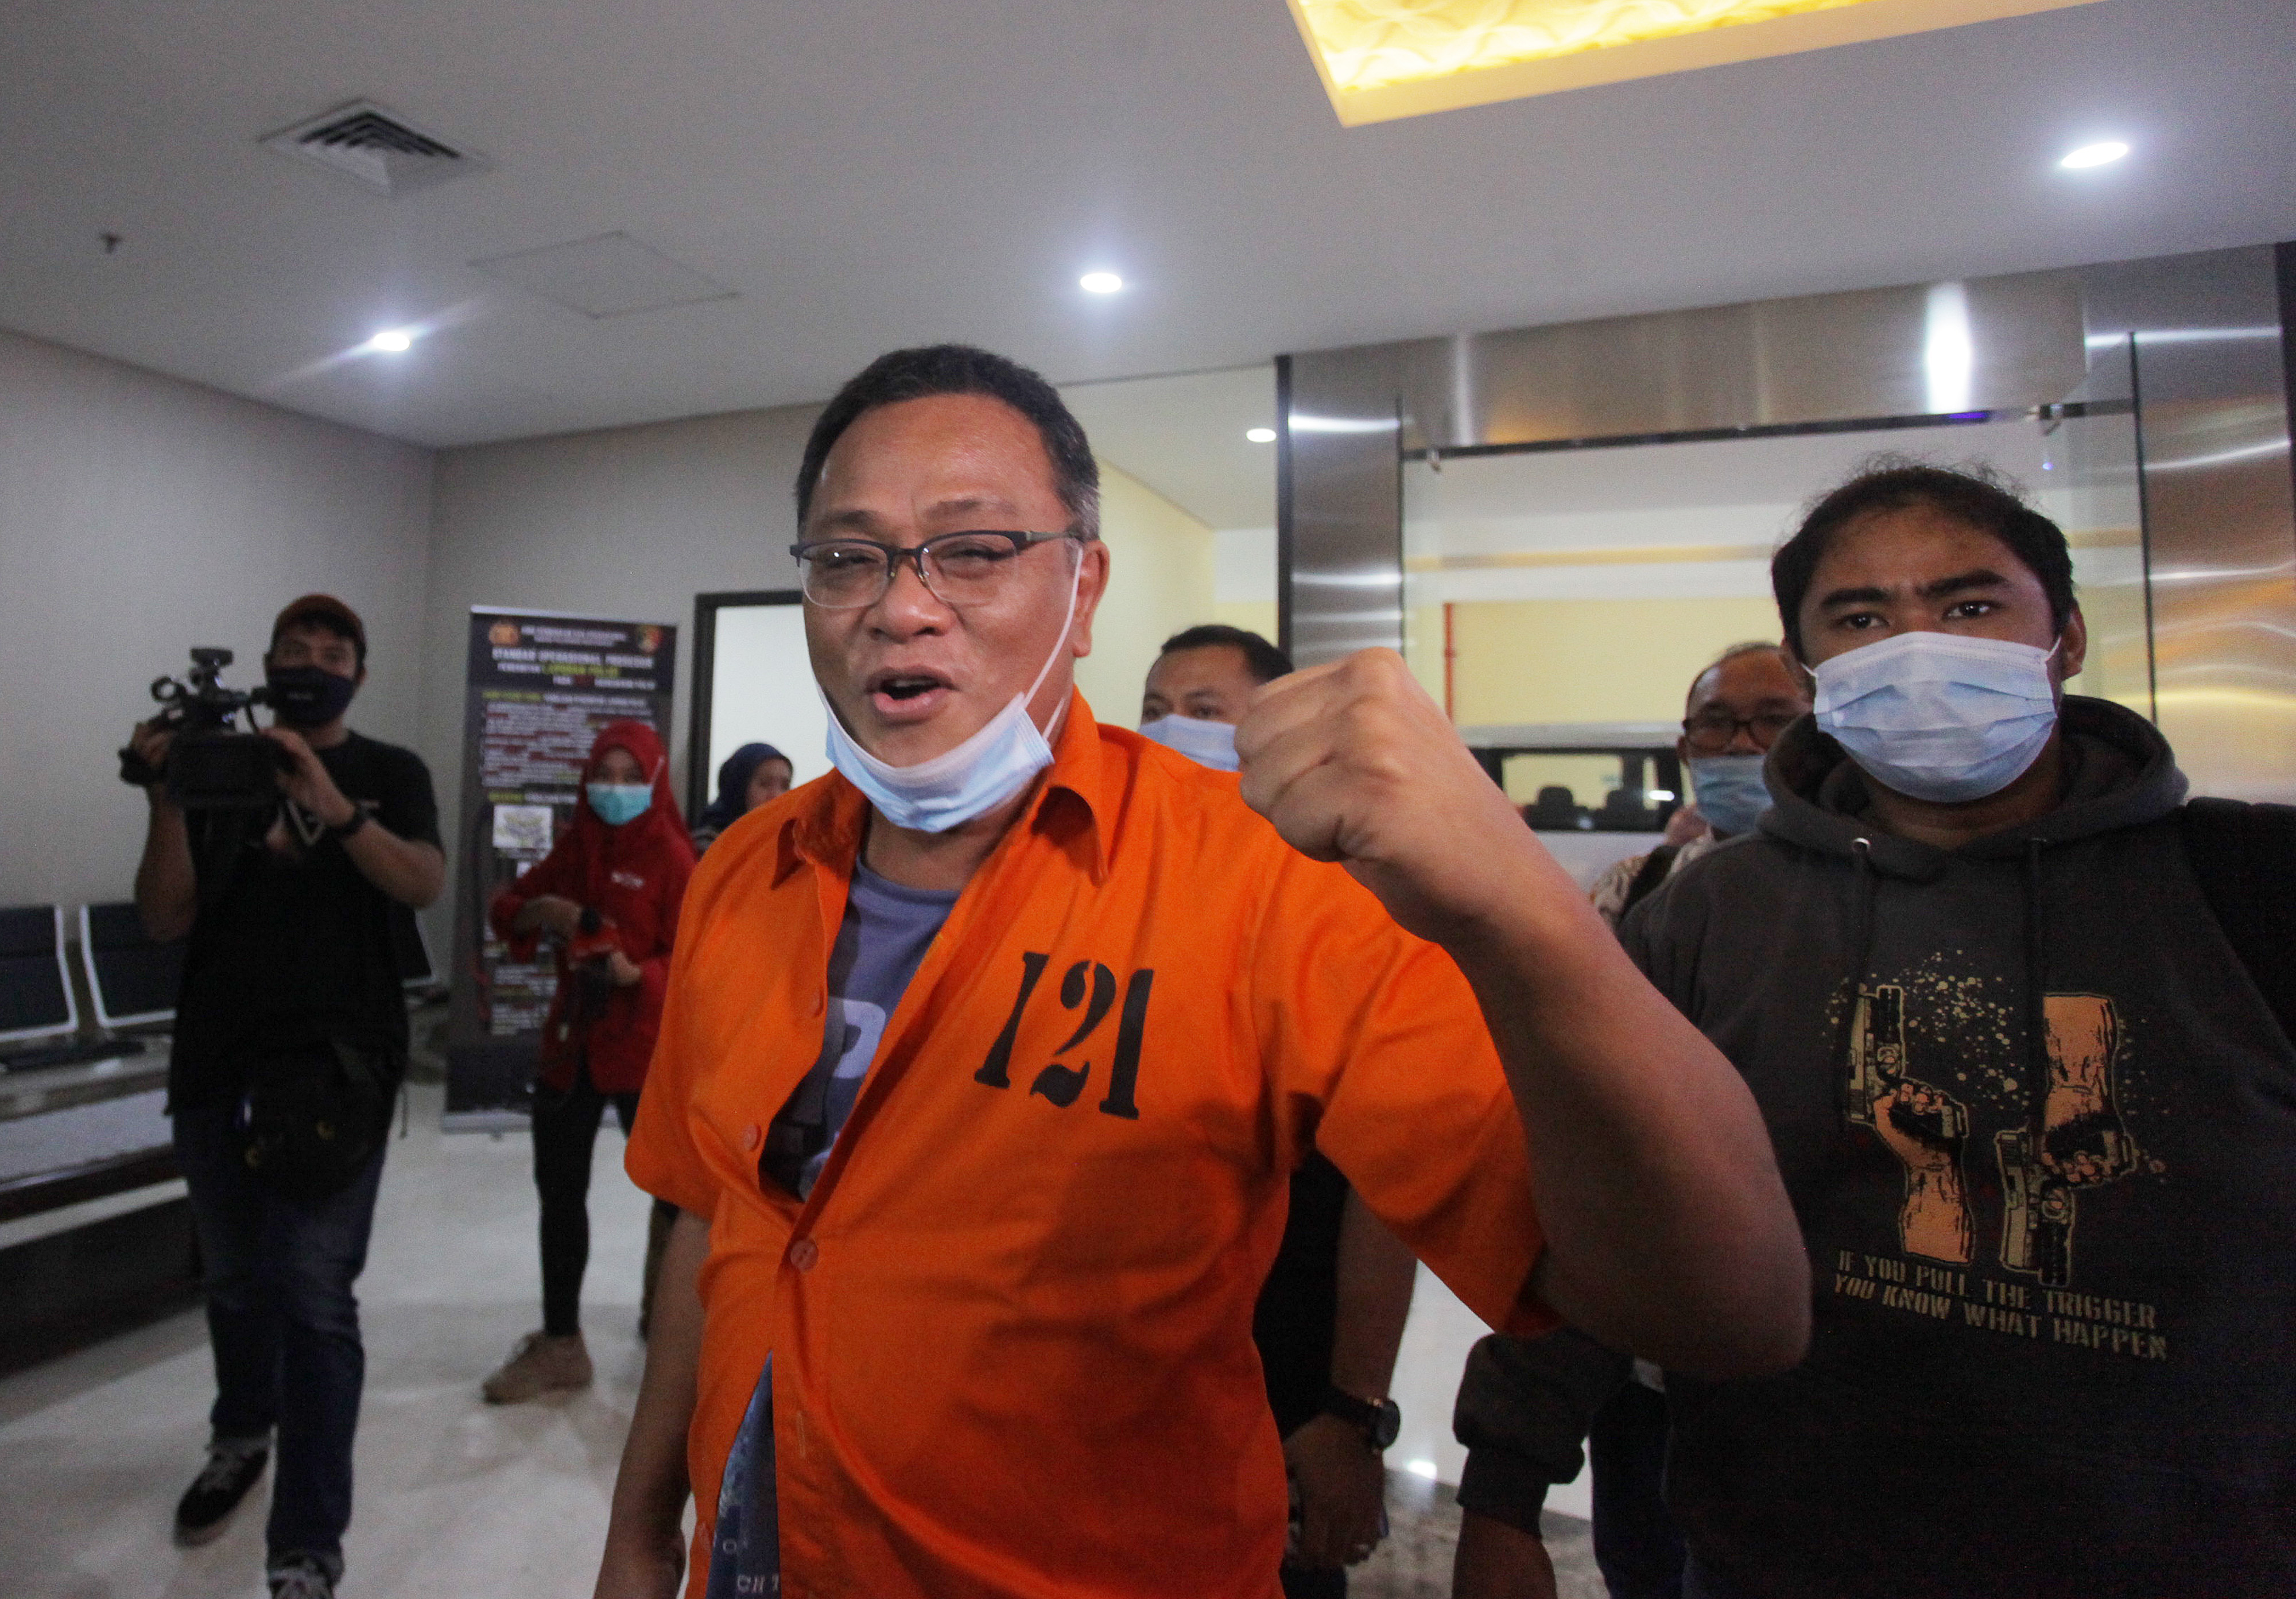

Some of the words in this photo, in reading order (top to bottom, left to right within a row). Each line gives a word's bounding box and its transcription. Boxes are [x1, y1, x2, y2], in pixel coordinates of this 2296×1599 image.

[974, 951, 1153, 1119] 121
[1834, 1272, 1876, 1300] YOU
[1881, 1284, 1951, 1319] KNOW
[1964, 1301, 2042, 1339] WHAT
[2053, 1317, 2167, 1360] HAPPEN
[1839, 1249, 1854, 1272] IF
[1864, 1254, 1906, 1283] YOU
[1917, 1264, 1970, 1297] PULL
[1981, 1279, 2031, 1311] THE
[2042, 1289, 2157, 1329] TRIGGER
